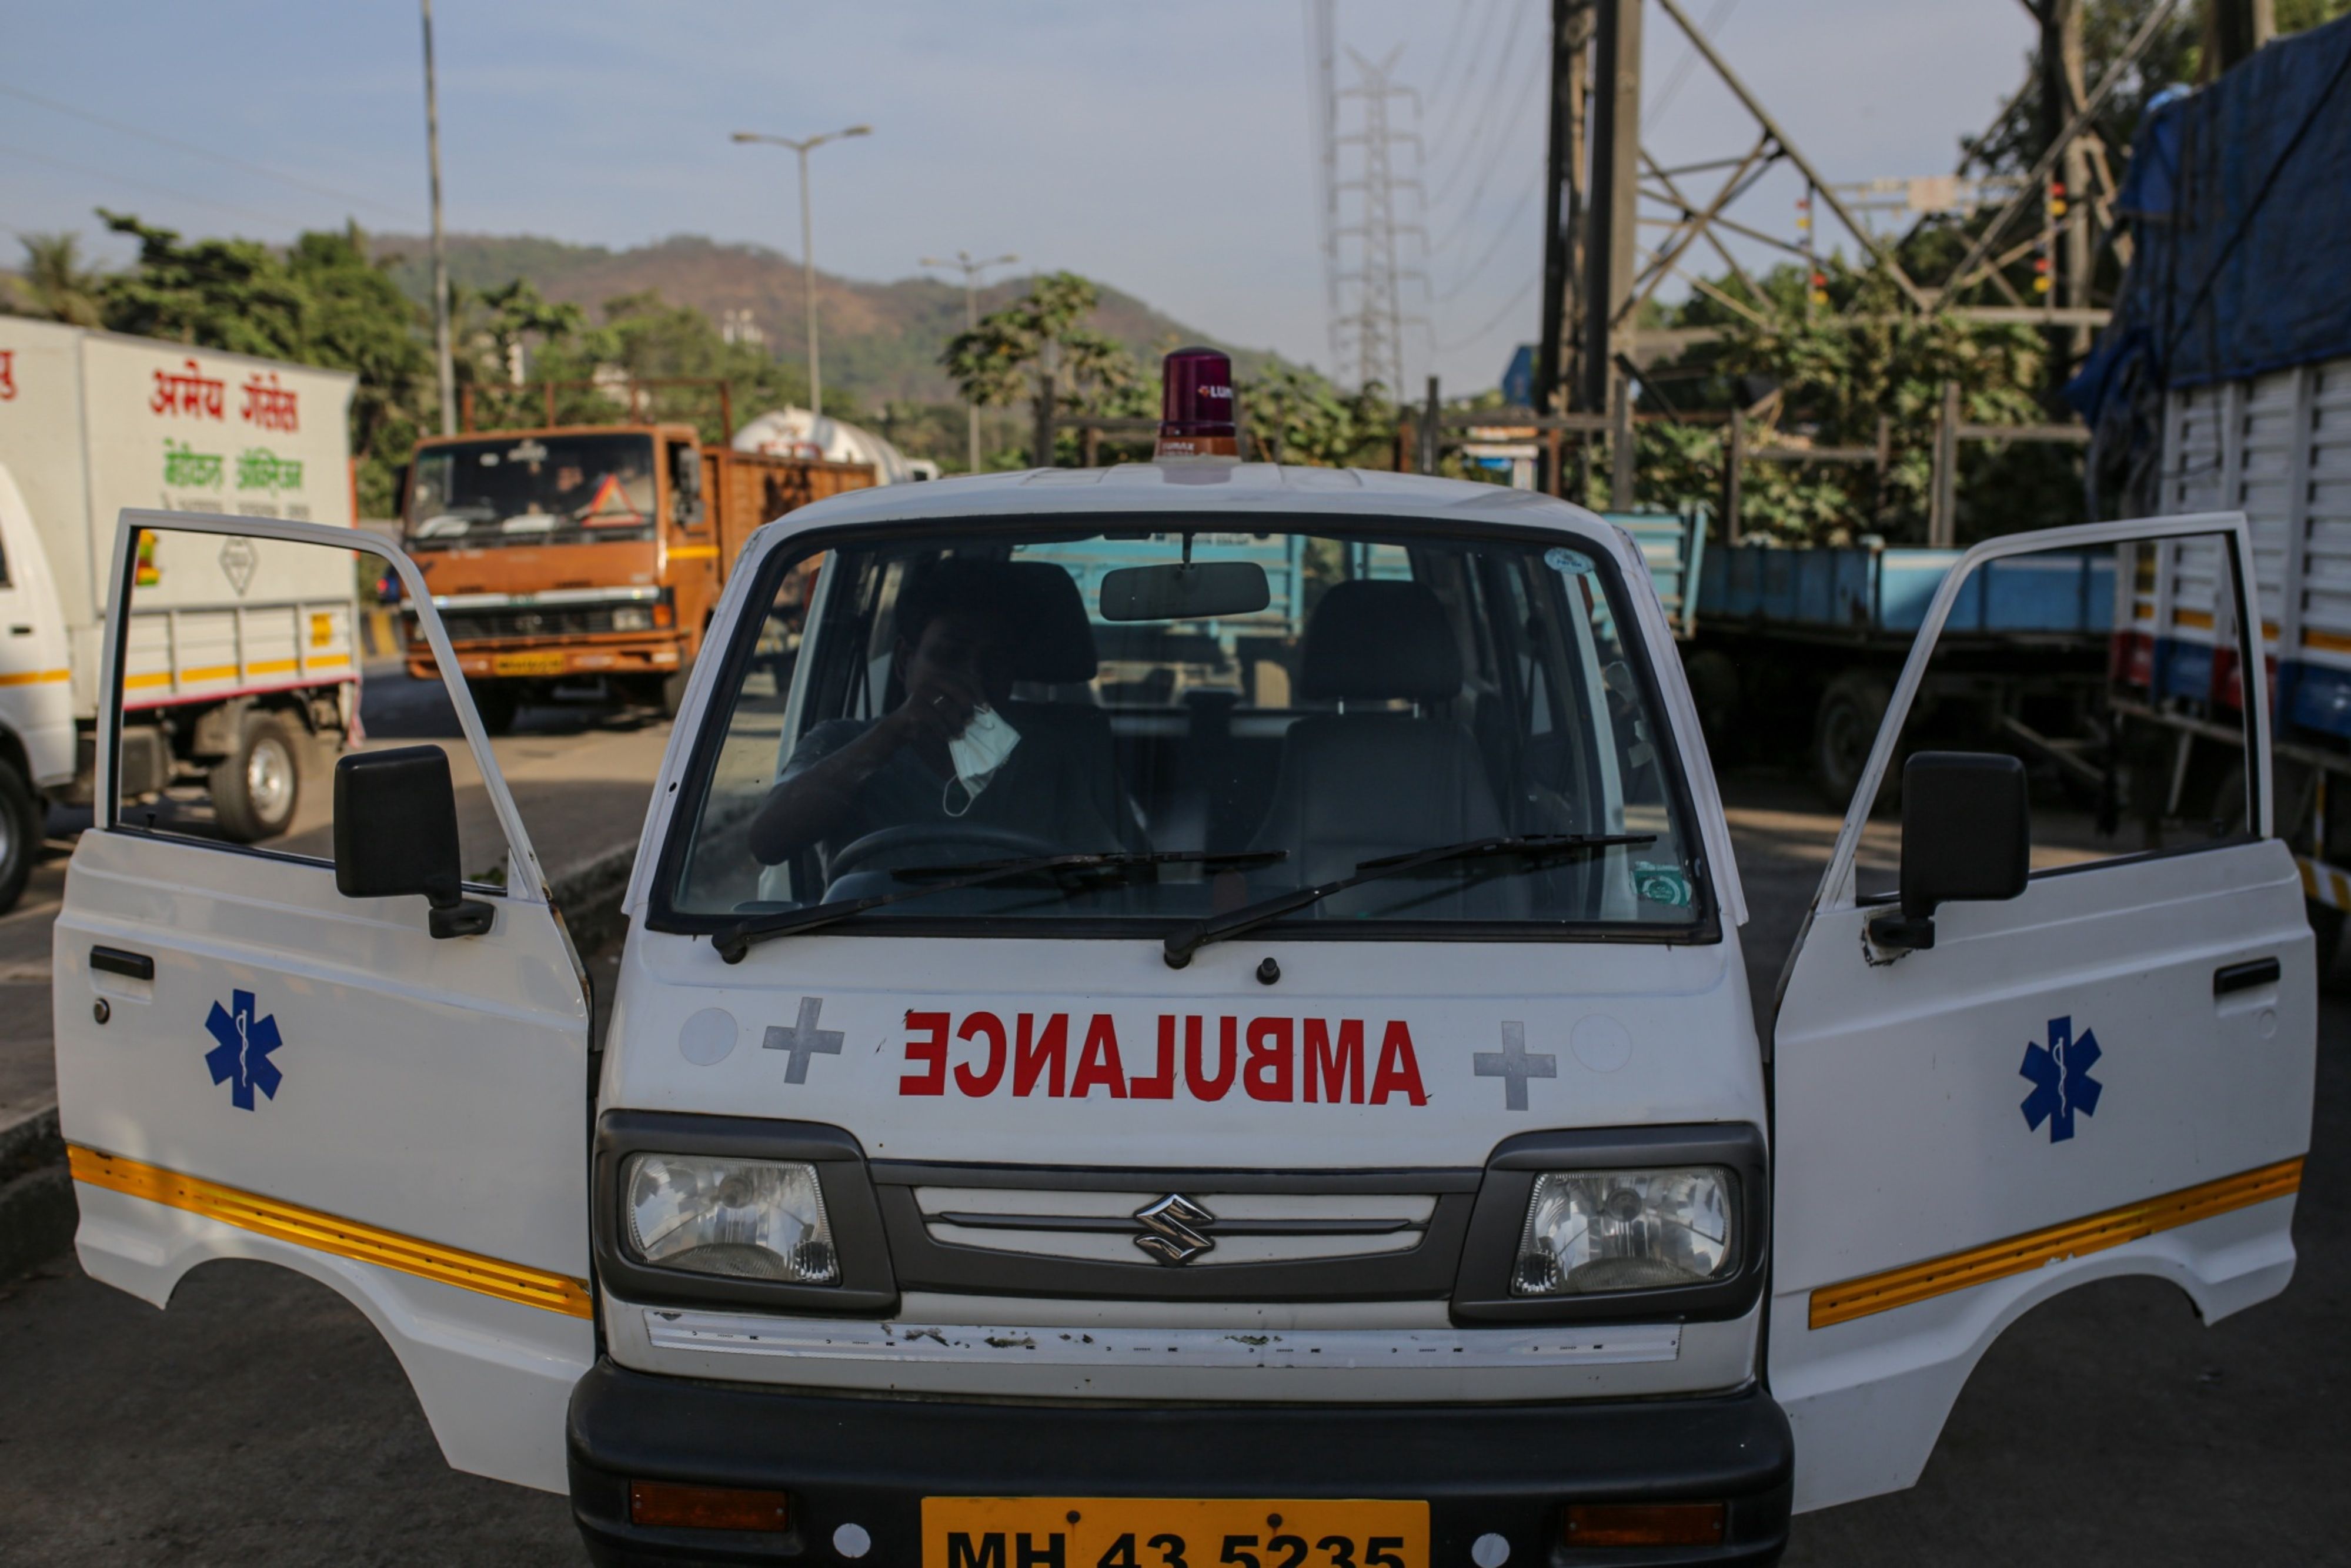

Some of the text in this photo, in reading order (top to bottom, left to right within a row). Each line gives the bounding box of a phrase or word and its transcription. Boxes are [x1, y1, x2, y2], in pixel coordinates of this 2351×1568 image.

[947, 1532, 1406, 1568] MH 43 5235
